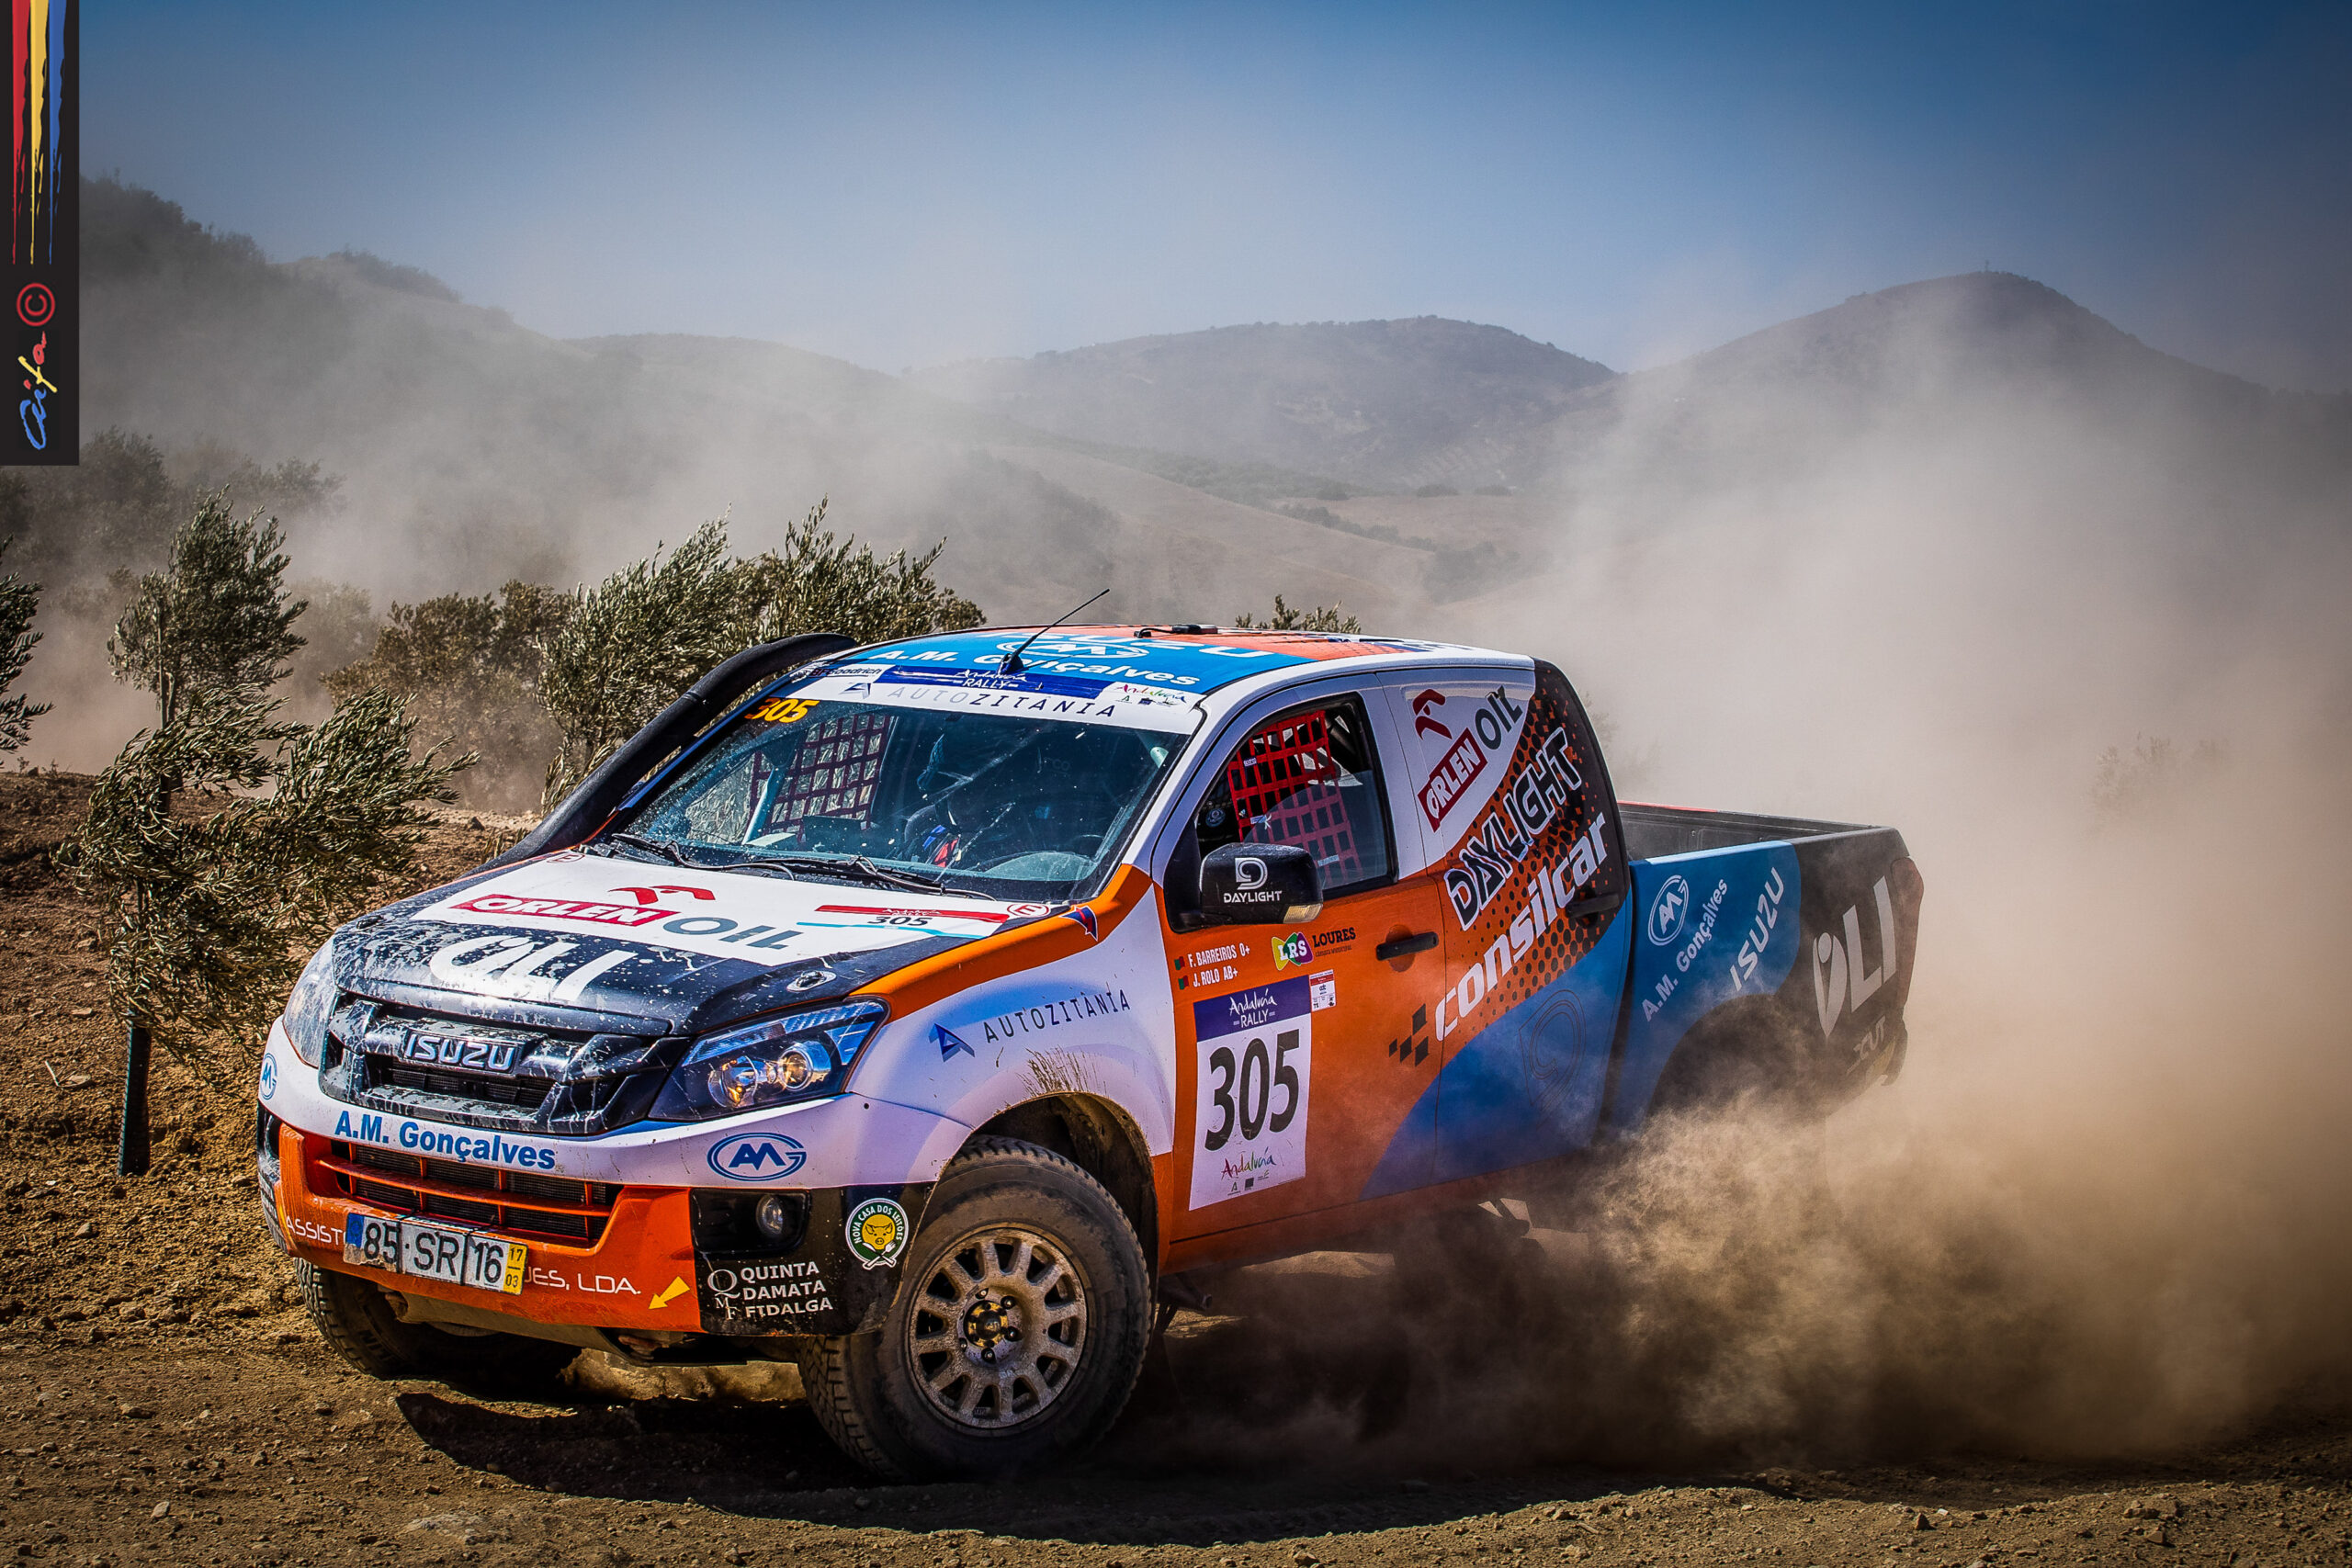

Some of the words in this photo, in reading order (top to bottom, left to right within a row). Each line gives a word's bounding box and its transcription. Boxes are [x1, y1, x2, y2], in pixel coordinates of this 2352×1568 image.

[866, 650, 959, 661] A.M.
[962, 678, 1012, 689] RALLY
[744, 697, 820, 724] 305
[1475, 685, 1523, 750] OIL
[1425, 739, 1481, 820] ORLEN
[1443, 727, 1581, 931] DAYLIGHT
[1223, 890, 1283, 904] DAYLIGHT
[471, 897, 655, 924] ORLEN
[662, 917, 805, 950] OIL
[867, 916, 933, 927] 305
[1434, 811, 1608, 1042] consilcar
[1729, 866, 1785, 992] ISUZU
[1312, 927, 1356, 948] LOURES
[1641, 976, 1679, 1022] A.M.
[1675, 878, 1728, 974] Gonçalves
[1187, 953, 1196, 967] F.
[1196, 944, 1237, 966] BARREIROS
[1278, 940, 1307, 961] LRS
[1193, 973, 1201, 987] J.
[1201, 968, 1220, 986] ROLO
[1223, 965, 1238, 981] AB+
[1229, 988, 1277, 1016] Andalucía
[1240, 1009, 1269, 1028] RALLY
[404, 1033, 515, 1071] ISUZU
[1204, 1029, 1300, 1151] 305
[334, 1110, 390, 1144] A.M.
[399, 1121, 556, 1169] Gonçalves
[1221, 1146, 1276, 1180] Andalucía
[286, 1215, 346, 1247] ASSIST
[853, 1222, 862, 1244] NOVA
[858, 1206, 876, 1221] CASA
[877, 1204, 893, 1215] DOS
[509, 1247, 524, 1262] 17
[504, 1273, 519, 1289] 03
[577, 1272, 641, 1295] LDA.
[741, 1261, 820, 1283] QUINTA
[742, 1280, 827, 1300] DAMATA
[745, 1297, 833, 1318] FIDALGA
